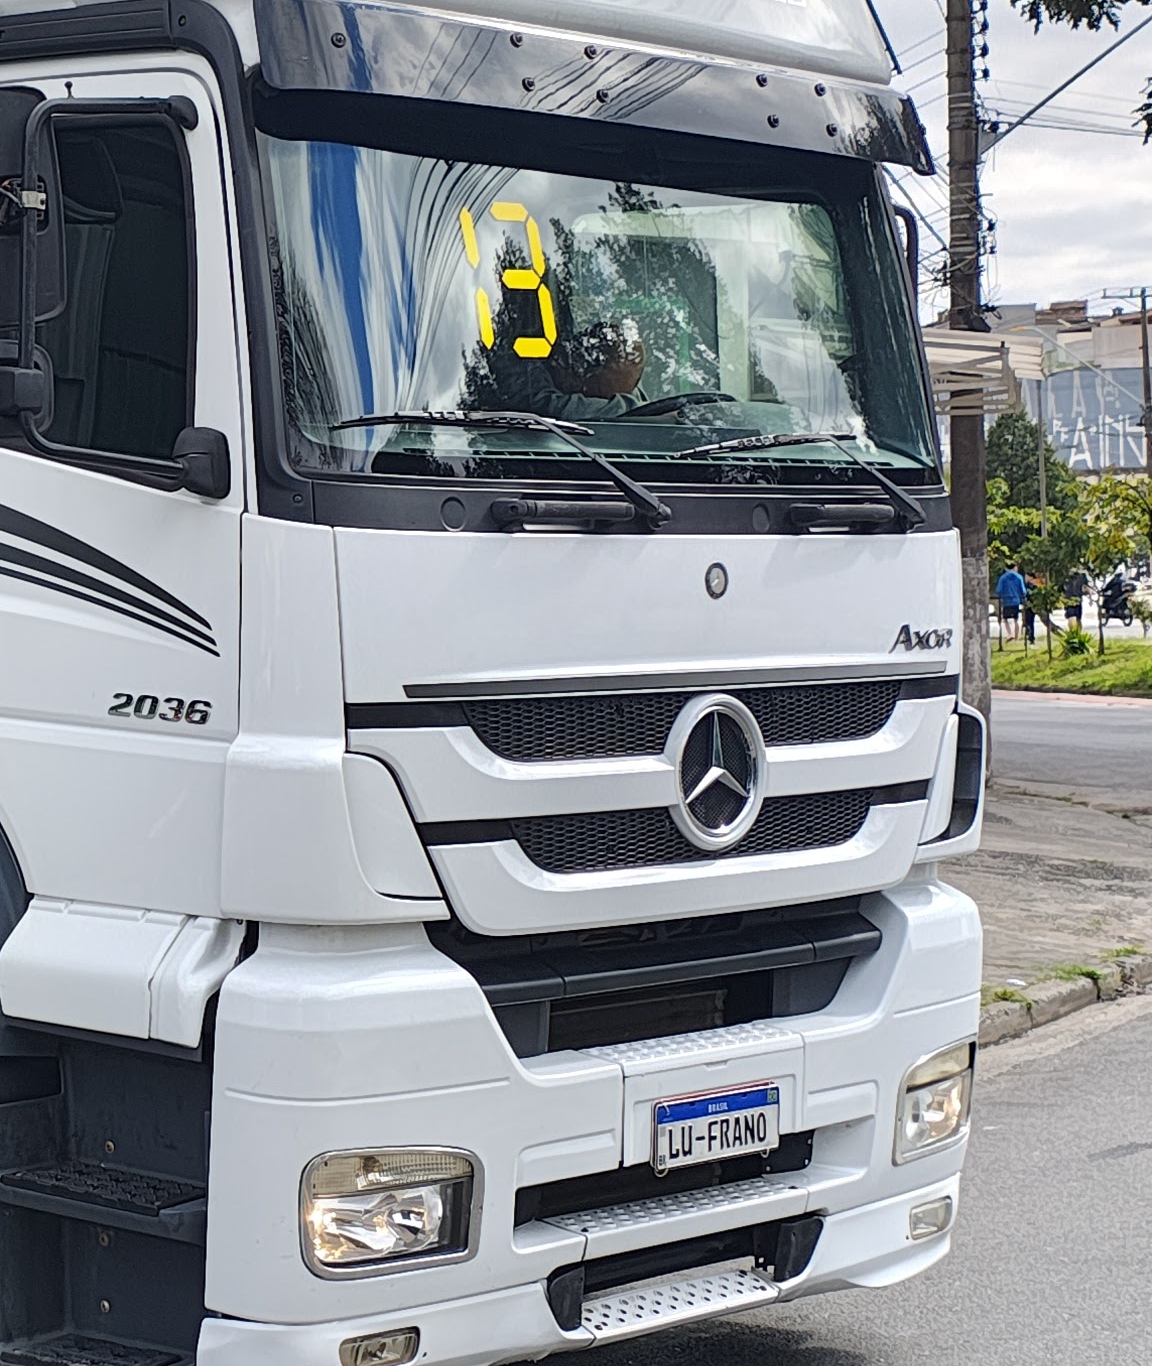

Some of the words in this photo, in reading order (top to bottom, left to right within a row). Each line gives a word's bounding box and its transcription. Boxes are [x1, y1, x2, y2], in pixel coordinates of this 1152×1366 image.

[459, 201, 558, 358] 13
[107, 692, 213, 725] 2036
[667, 1111, 768, 1160] LU-FRANO
